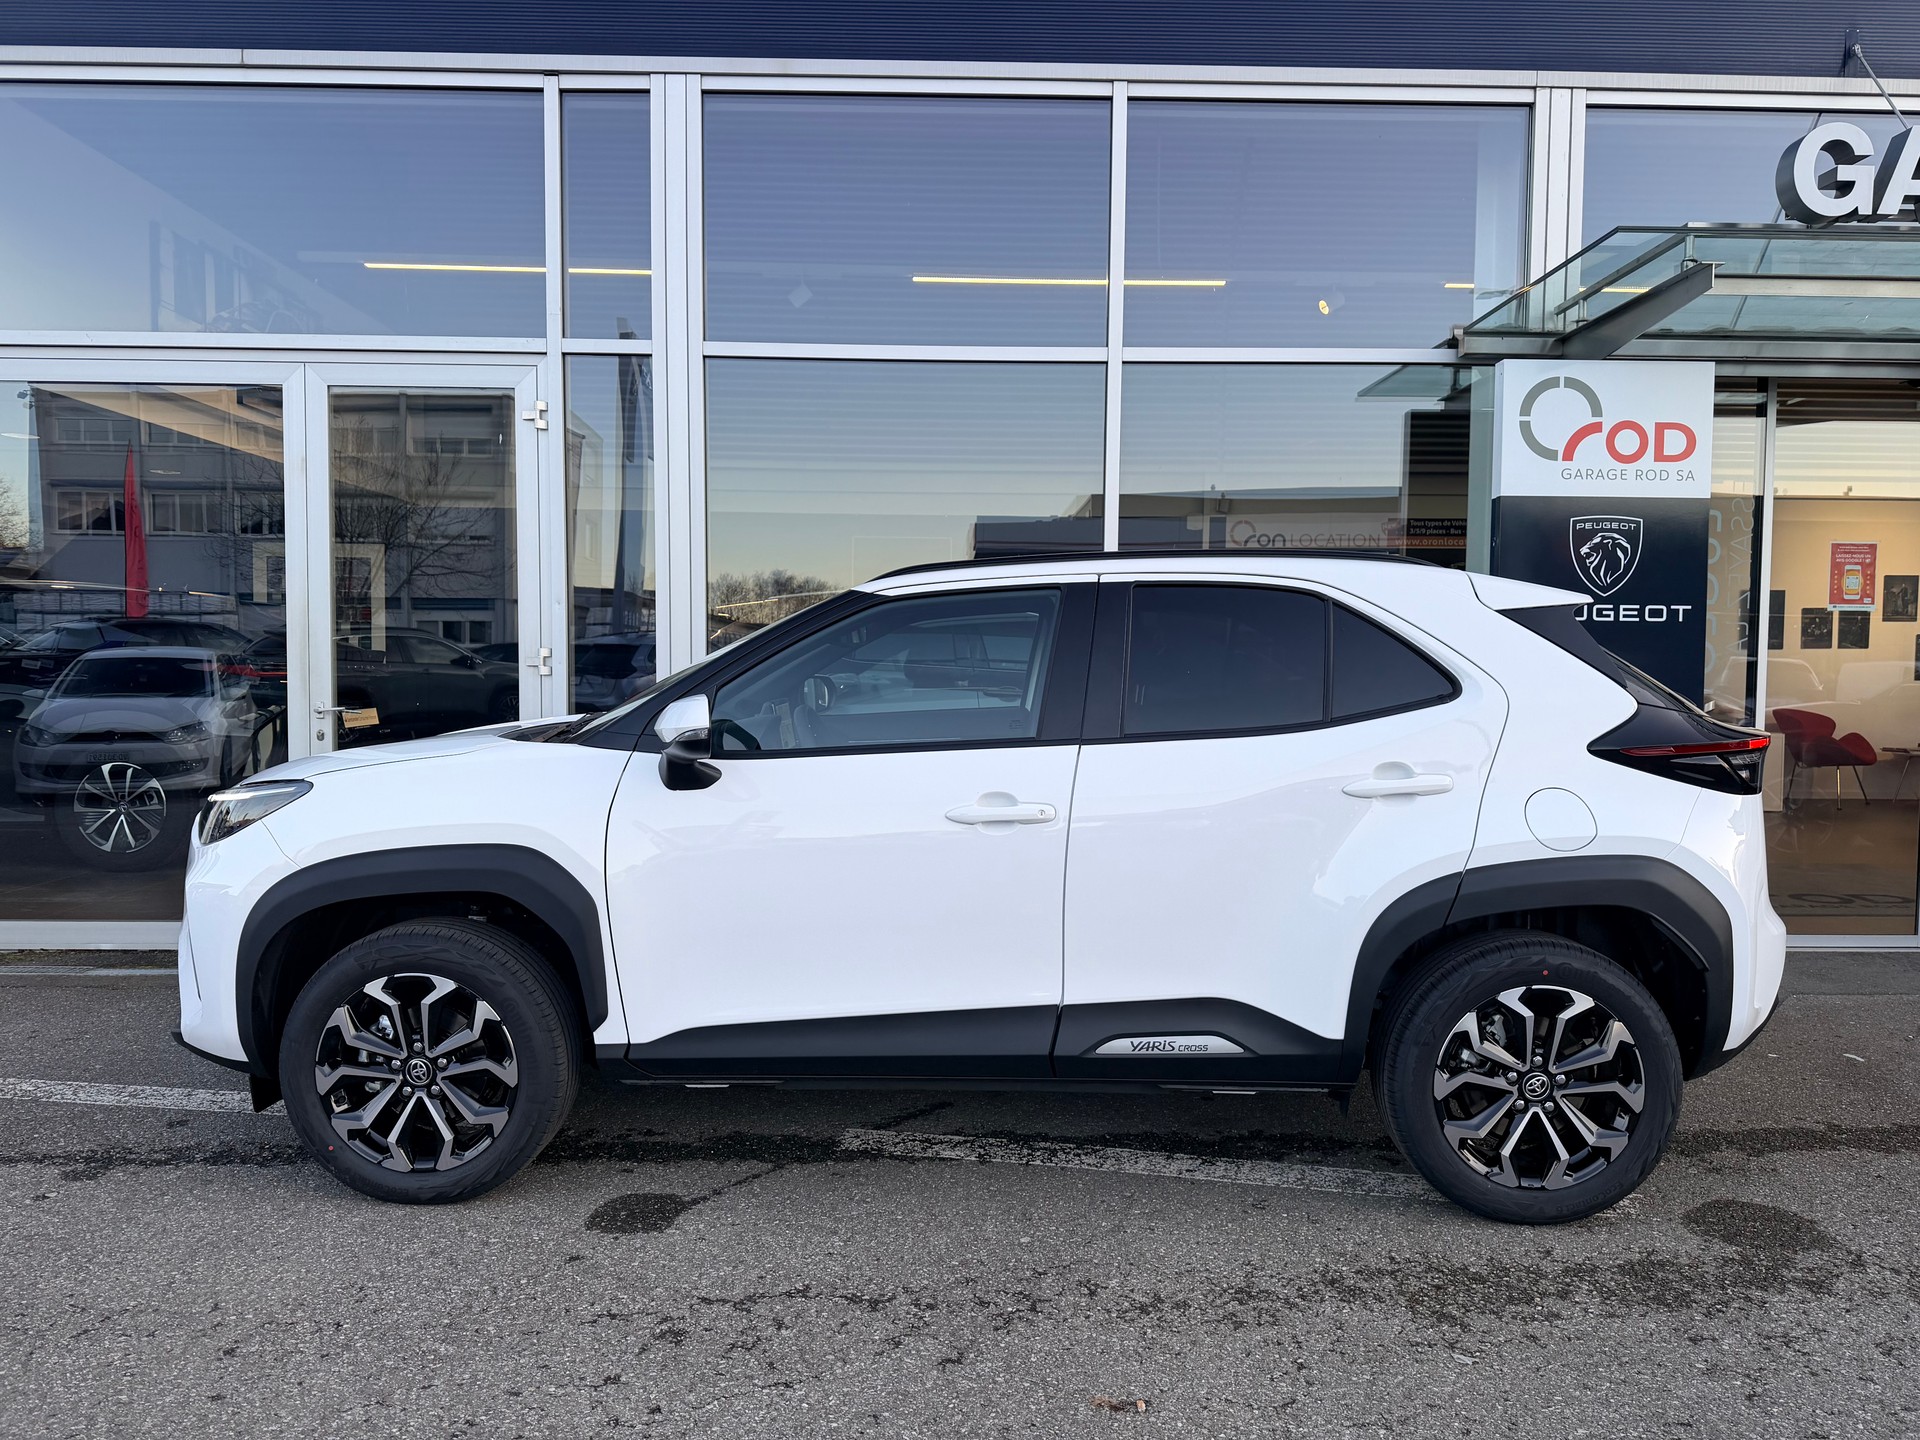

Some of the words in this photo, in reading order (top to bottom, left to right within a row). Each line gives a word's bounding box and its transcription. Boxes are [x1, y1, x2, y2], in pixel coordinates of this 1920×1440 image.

[1561, 468, 1628, 481] GARAGE
[1635, 469, 1670, 481] ROD
[1676, 469, 1696, 482] SA
[1576, 521, 1637, 531] PEUGEOT
[1291, 533, 1380, 547] LOCATION
[1575, 604, 1692, 622] UGEOT
